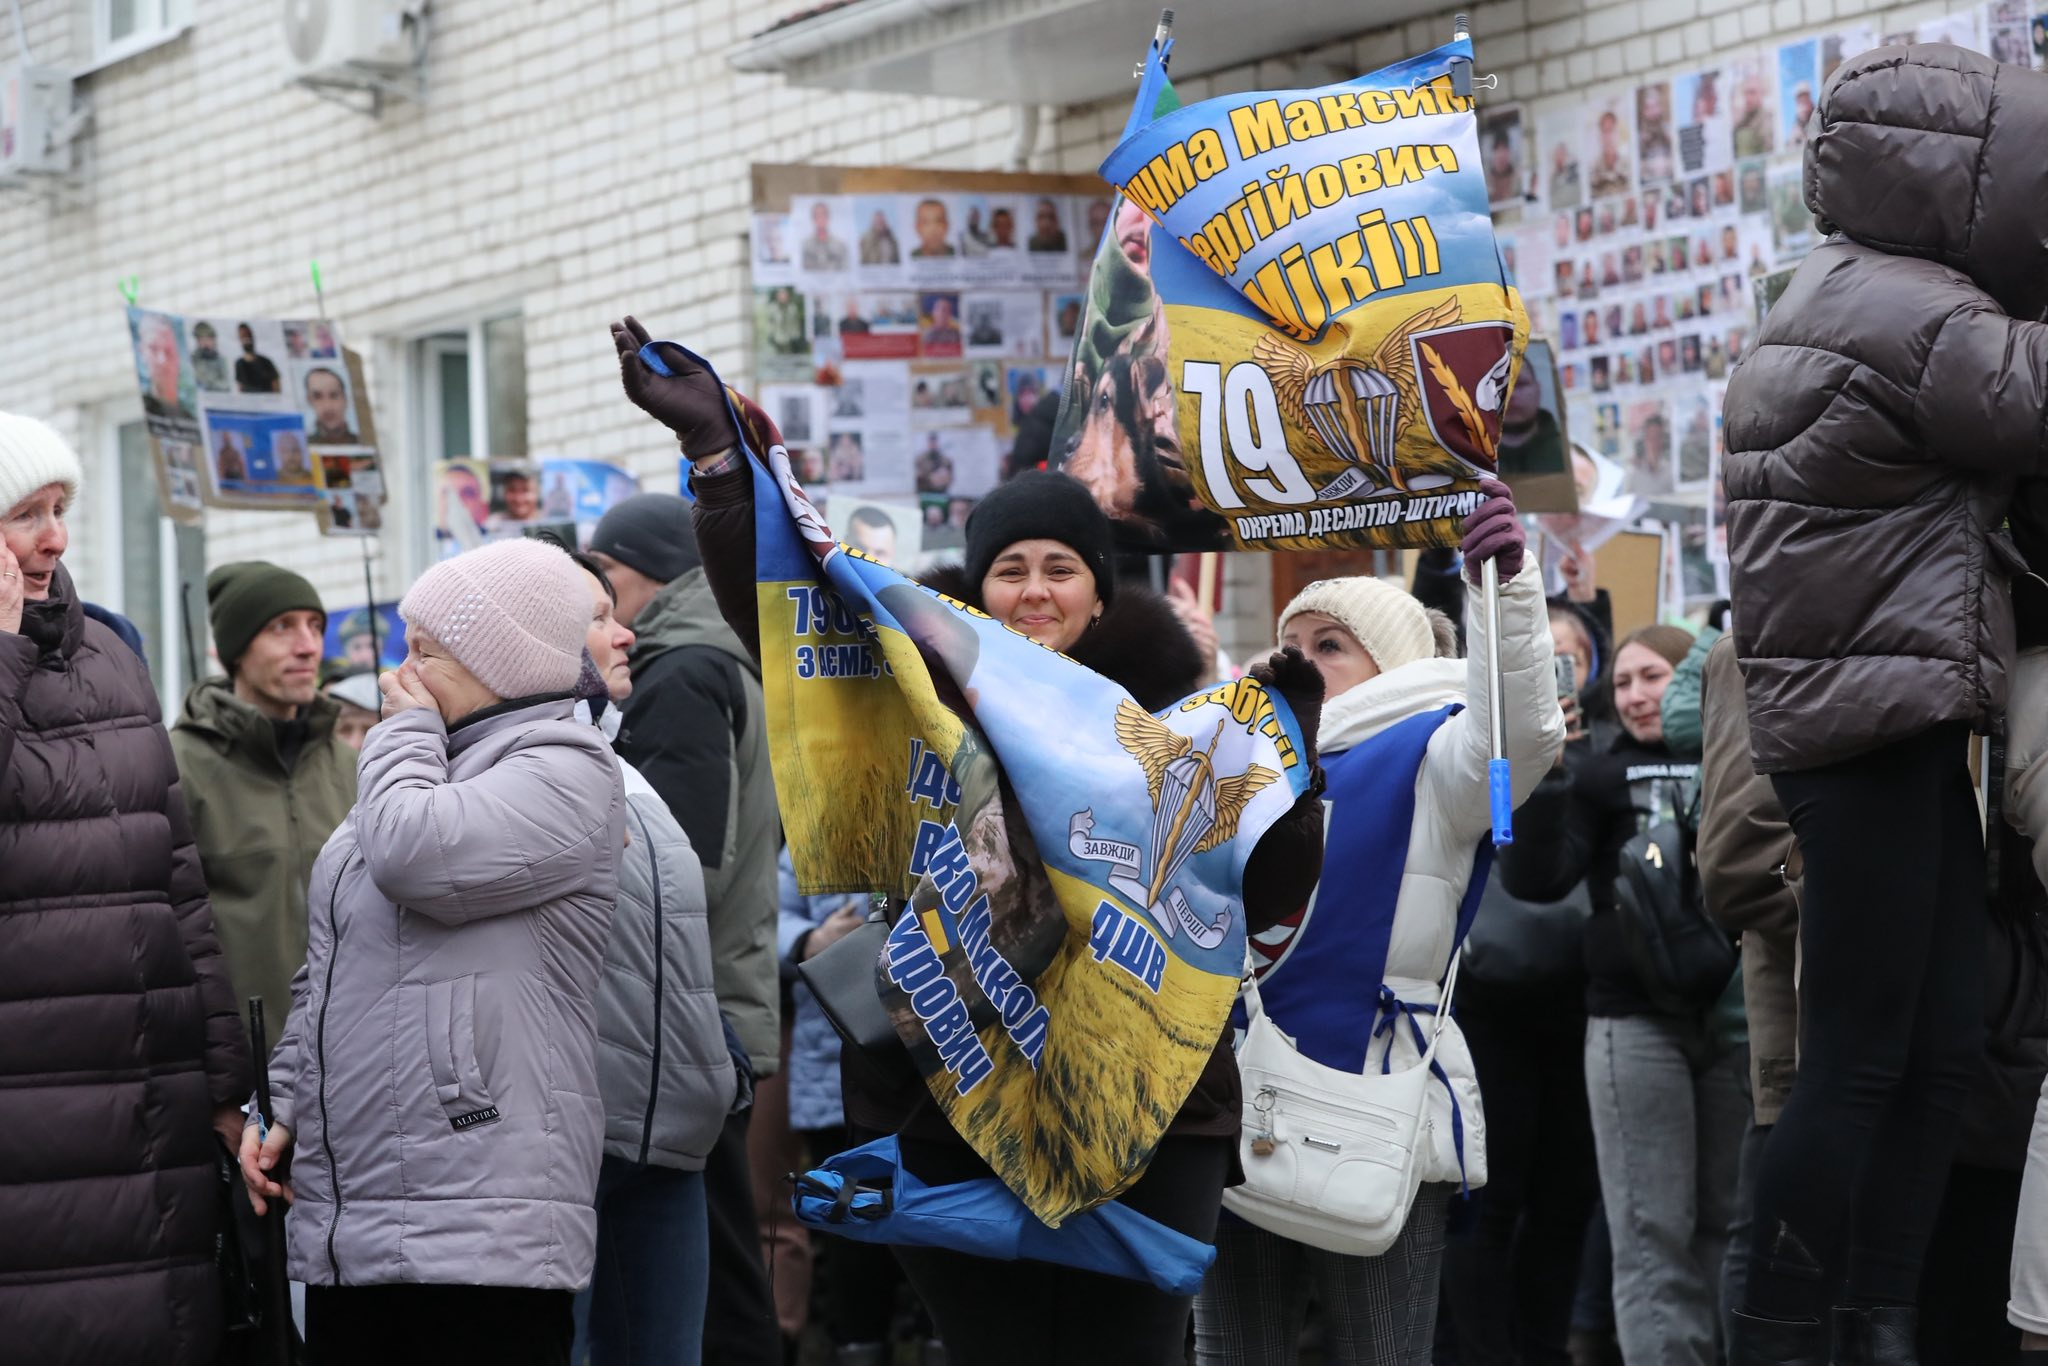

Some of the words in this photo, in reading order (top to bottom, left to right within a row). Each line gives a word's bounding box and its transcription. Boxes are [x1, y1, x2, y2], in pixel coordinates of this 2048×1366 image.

[1178, 144, 1459, 278] ергійович
[1182, 359, 1318, 510] 79
[1317, 472, 1358, 499] АВЖДИ
[1235, 512, 1306, 541] ОКРЕМА
[1084, 841, 1135, 862] ЗАВЖДИ
[1088, 899, 1167, 995] ДШВ
[1176, 898, 1206, 939] ПЕРШІ
[887, 895, 995, 1097] ирович
[957, 893, 1050, 1074] Микол
[456, 1107, 498, 1127] ALLVIRA
